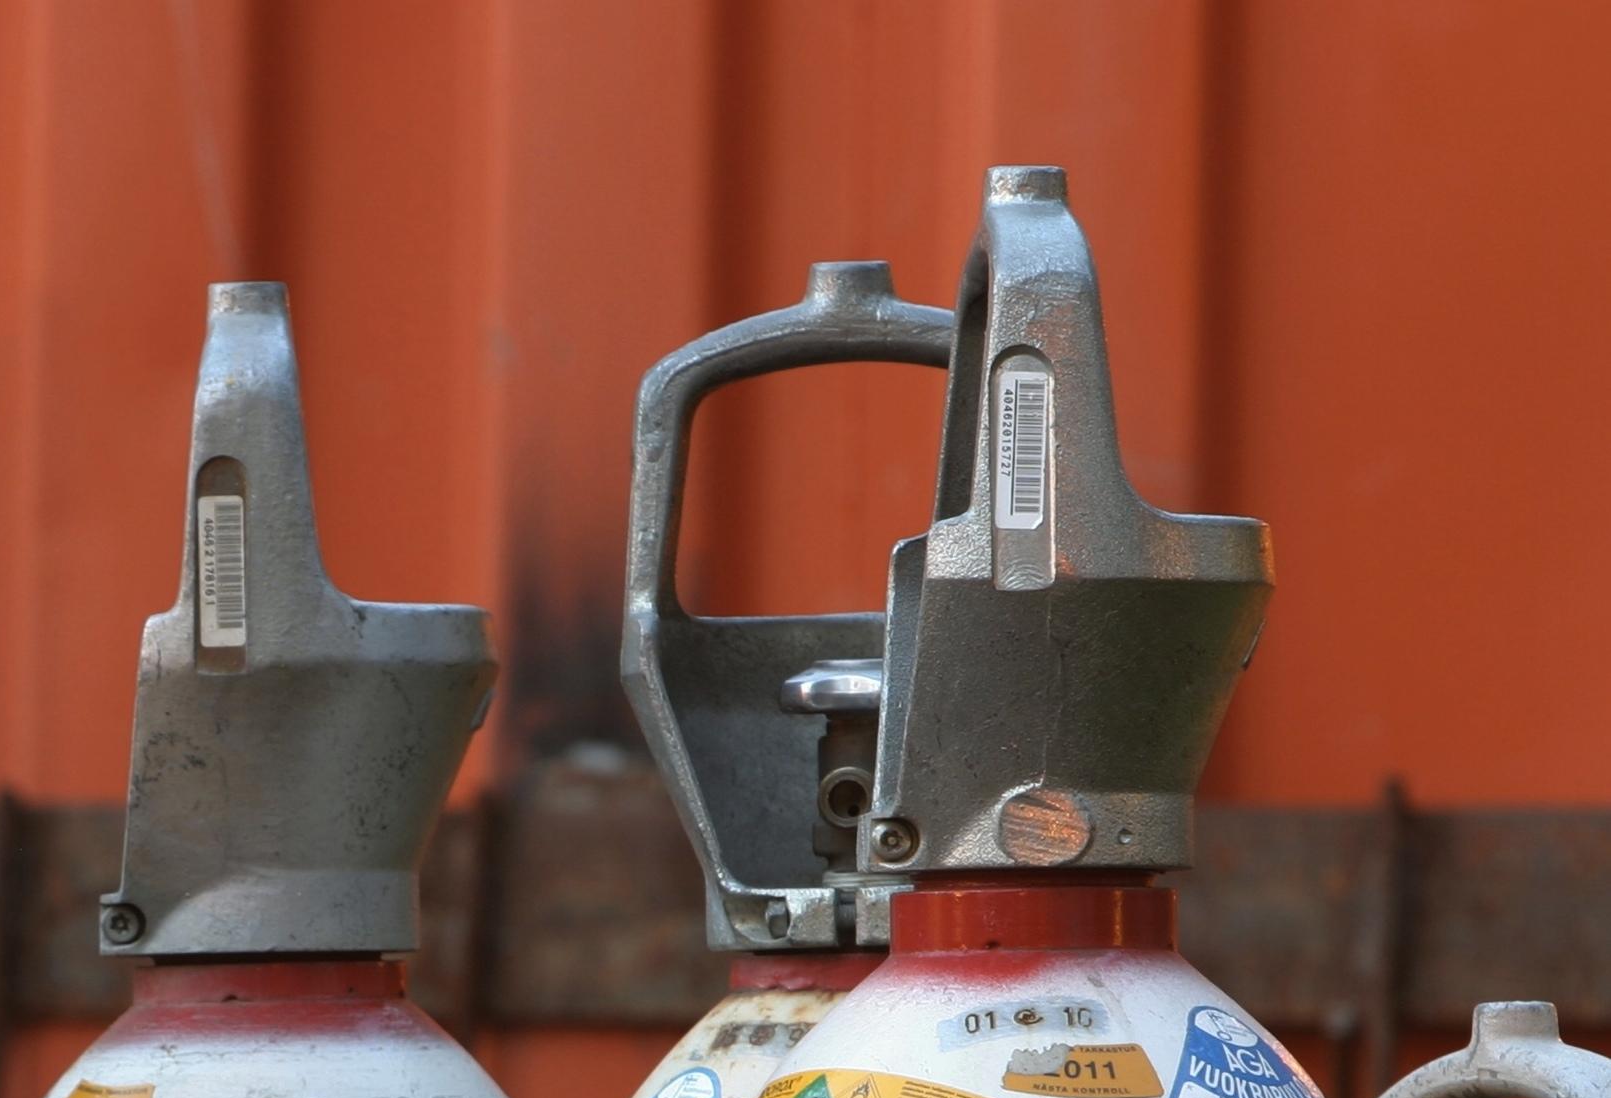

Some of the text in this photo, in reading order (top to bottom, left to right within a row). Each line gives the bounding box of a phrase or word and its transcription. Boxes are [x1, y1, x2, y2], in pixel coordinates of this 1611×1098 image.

[964, 1010, 997, 1034] 01
[1043, 1060, 1117, 1080] 011
[1222, 1043, 1279, 1081] AGA
[1072, 1085, 1131, 1095] KONTROLL
